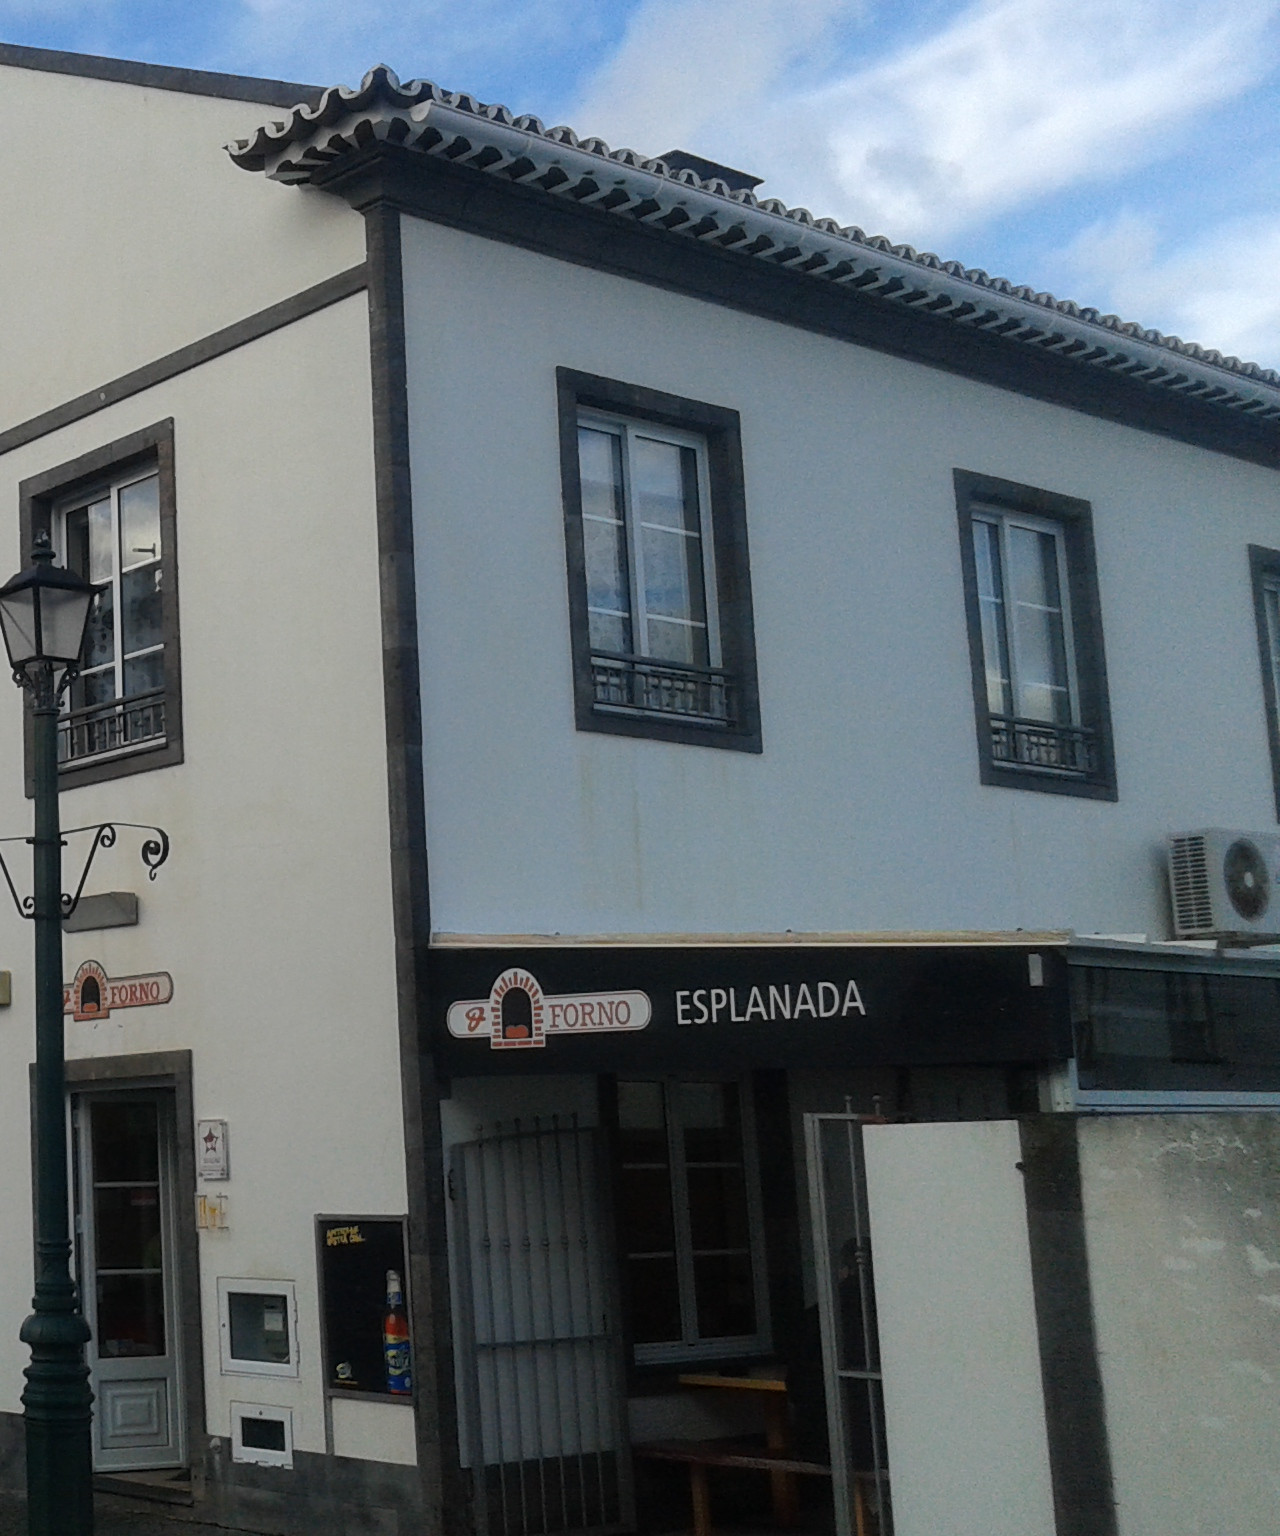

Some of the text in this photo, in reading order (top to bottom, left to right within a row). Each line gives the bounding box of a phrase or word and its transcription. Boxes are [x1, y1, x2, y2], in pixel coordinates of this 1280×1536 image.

[110, 981, 160, 1004] FORNO
[548, 1000, 631, 1029] FORNO
[675, 979, 867, 1026] ESPLANADA
